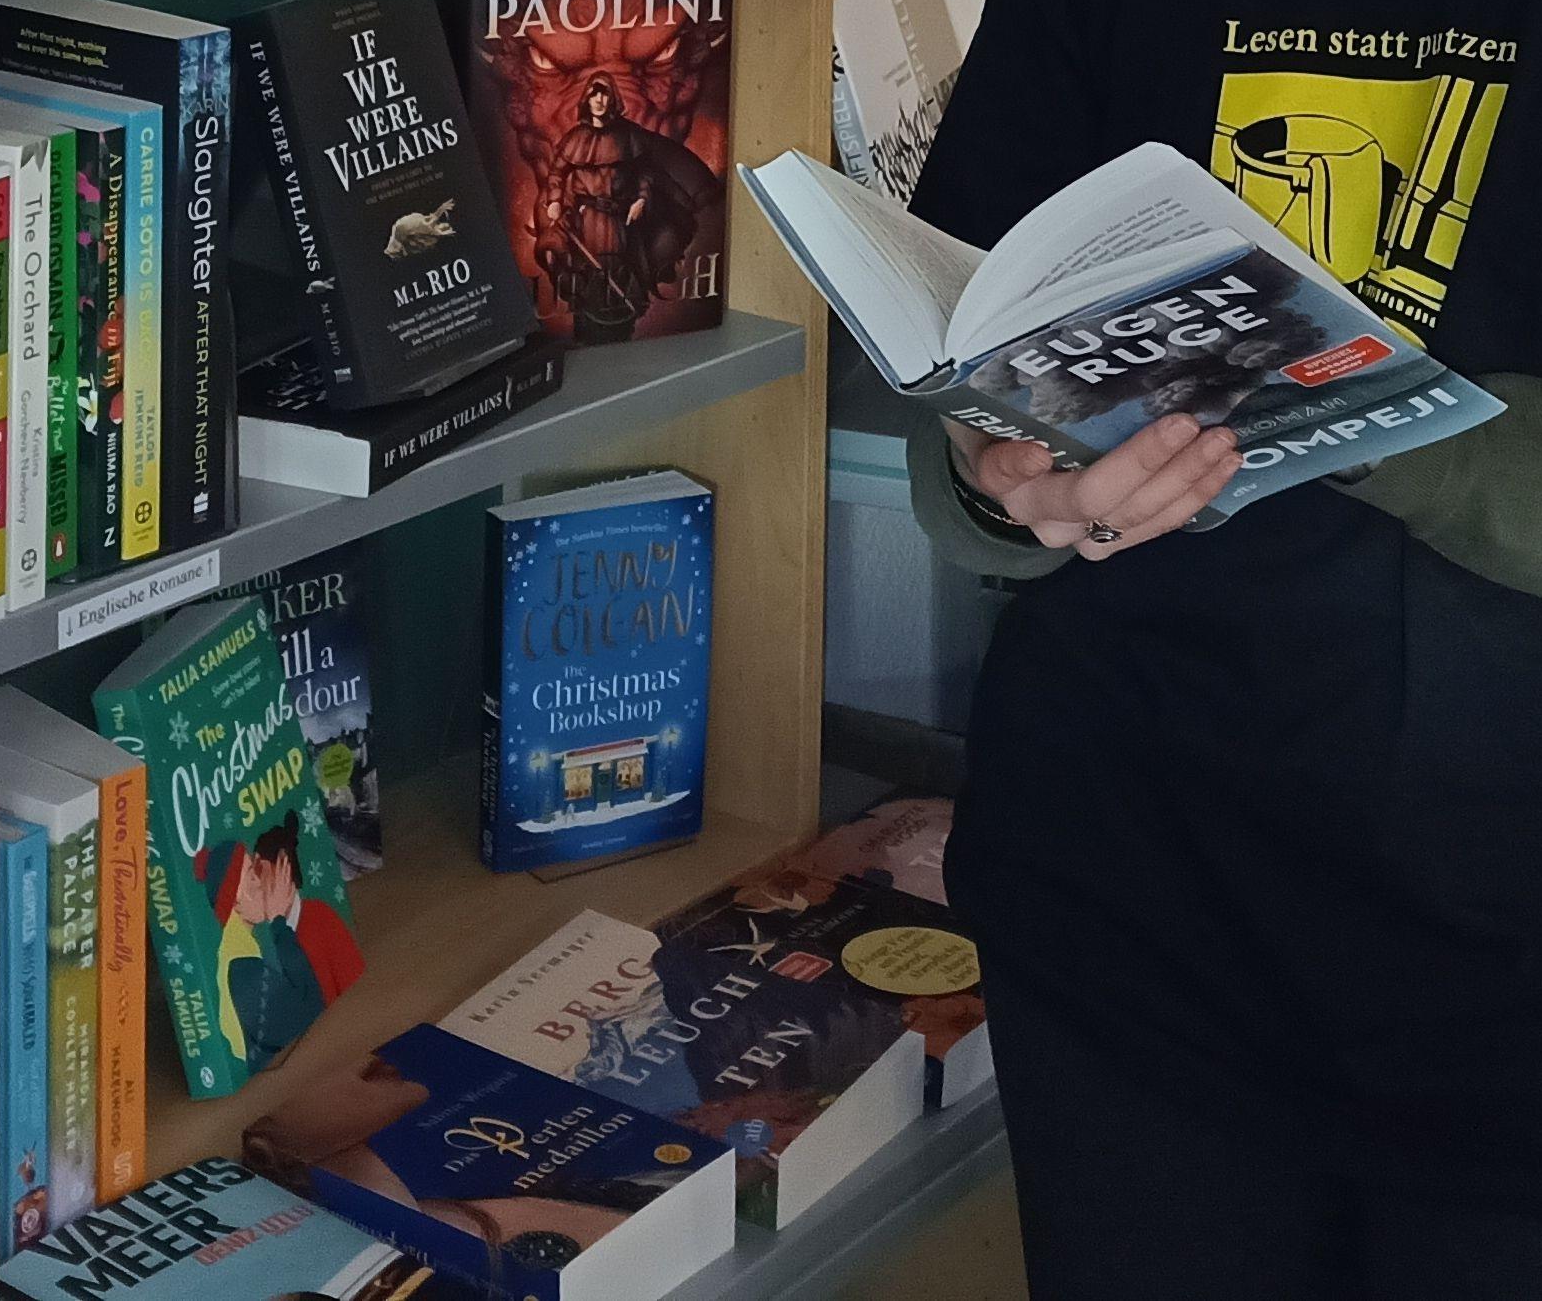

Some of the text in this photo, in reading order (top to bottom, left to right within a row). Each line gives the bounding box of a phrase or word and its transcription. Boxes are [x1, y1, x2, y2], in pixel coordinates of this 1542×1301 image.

[342, 56, 405, 108] WE
[350, 29, 377, 63] IF
[1223, 19, 1519, 69] Lesen statt putzen
[179, 97, 229, 117] KARIN
[345, 95, 424, 146] WERE
[248, 40, 322, 274] IF WE WERE VILLAINS
[323, 117, 458, 194] VILLAINS
[188, 115, 219, 295] Slaughter
[22, 194, 43, 362] The Orchard
[102, 153, 122, 387] A Disappearance in Fiji
[1009, 274, 1259, 379] EUGEN
[1066, 305, 1269, 385] RUGE
[1302, 347, 1358, 372] SPIEGEL
[1303, 348, 1373, 379] Bestseller-
[194, 300, 209, 486] AFTER THAT NIGHT
[382, 390, 504, 469] IF WE WERE VILLAINS
[1236, 395, 1349, 441] ROMAN
[1239, 386, 1459, 470] OMPEJI
[78, 564, 204, 632] Englische Romane
[270, 572, 348, 624] KER
[544, 539, 679, 606] JENNY
[280, 627, 335, 680] ill a
[521, 582, 695, 662] COLGAN
[158, 619, 257, 705] TALIA SAMUELS
[294, 674, 362, 718] dour
[532, 666, 681, 713] Christmas
[563, 664, 587, 680] The
[195, 722, 227, 753] The
[549, 698, 662, 735] Bookshop
[236, 747, 304, 829] SWAP
[62, 855, 77, 954] PALACE
[80, 828, 95, 970] THE PAPER
[186, 989, 209, 1042] TALIA
[469, 928, 596, 1025] Karin Seemayer
[533, 957, 657, 1044] BERG
[169, 977, 201, 1058] SAMUELS
[607, 971, 762, 1091] LEUCH
[714, 1018, 817, 1092] TEN
[443, 1149, 483, 1175] Das
[513, 1111, 634, 1192] medaillon
[33, 1158, 254, 1265] VATERS
[55, 1204, 243, 1301] MEER
